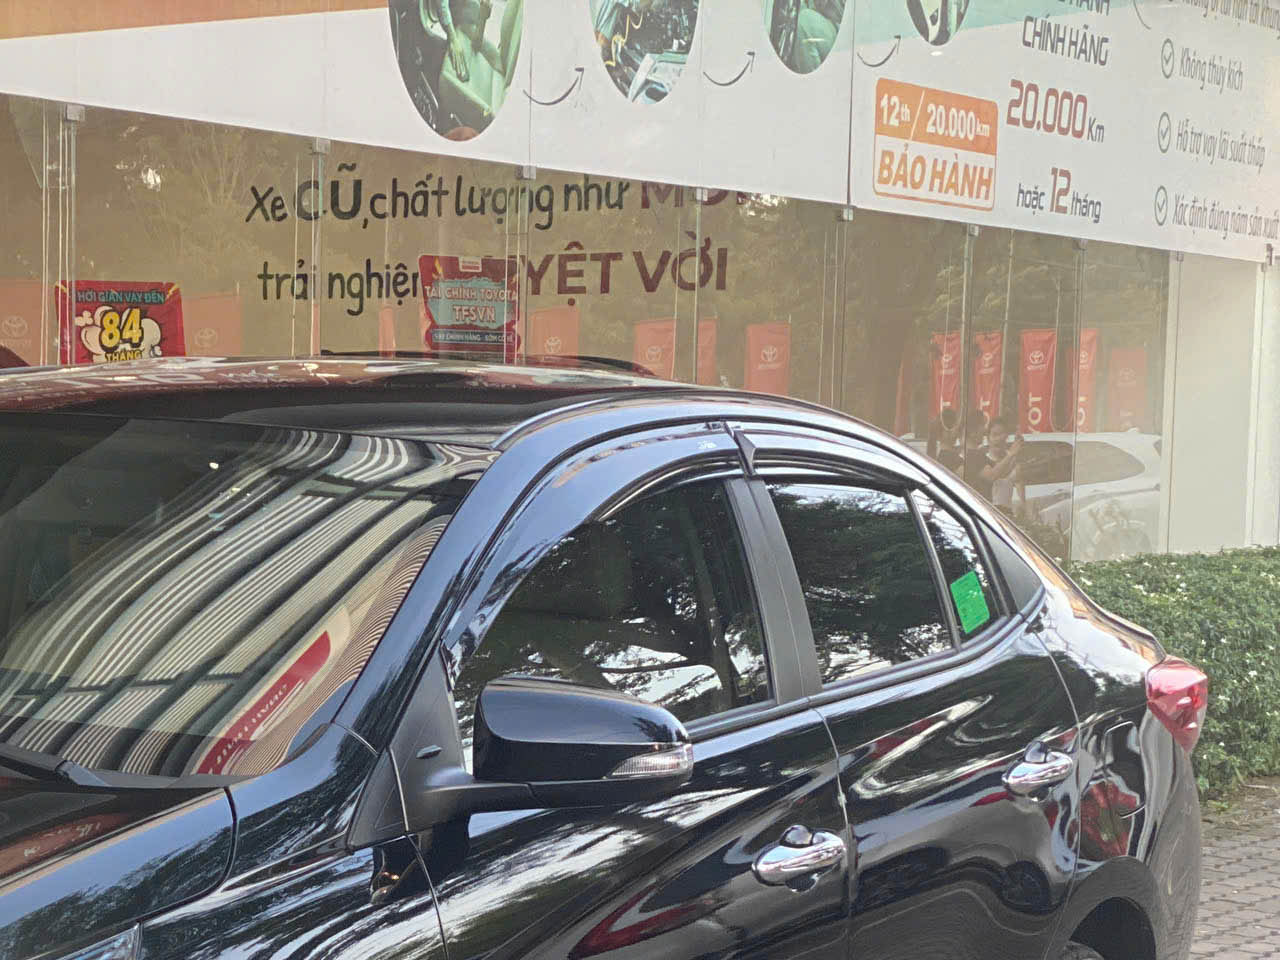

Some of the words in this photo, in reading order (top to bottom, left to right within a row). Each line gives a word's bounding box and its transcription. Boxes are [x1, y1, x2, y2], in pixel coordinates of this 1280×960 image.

[1022, 14, 1067, 57] CHÍNH
[1068, 24, 1109, 66] HÃNG
[1180, 47, 1207, 90] Không
[1006, 79, 1088, 139] 20.000
[877, 143, 926, 190] BẢO
[928, 154, 994, 201] HÀNH
[1203, 133, 1217, 165] vay
[245, 185, 288, 223] Xe
[455, 175, 554, 230] lượng
[564, 173, 630, 212] như
[1016, 184, 1045, 216] hoặc
[1050, 167, 1072, 214] 12
[1070, 191, 1102, 224] tháng
[257, 258, 319, 301] trải
[632, 230, 728, 294] VỜI
[100, 307, 143, 350] 84
[453, 304, 496, 323] TFSVN
[105, 348, 142, 361] THÁNG
